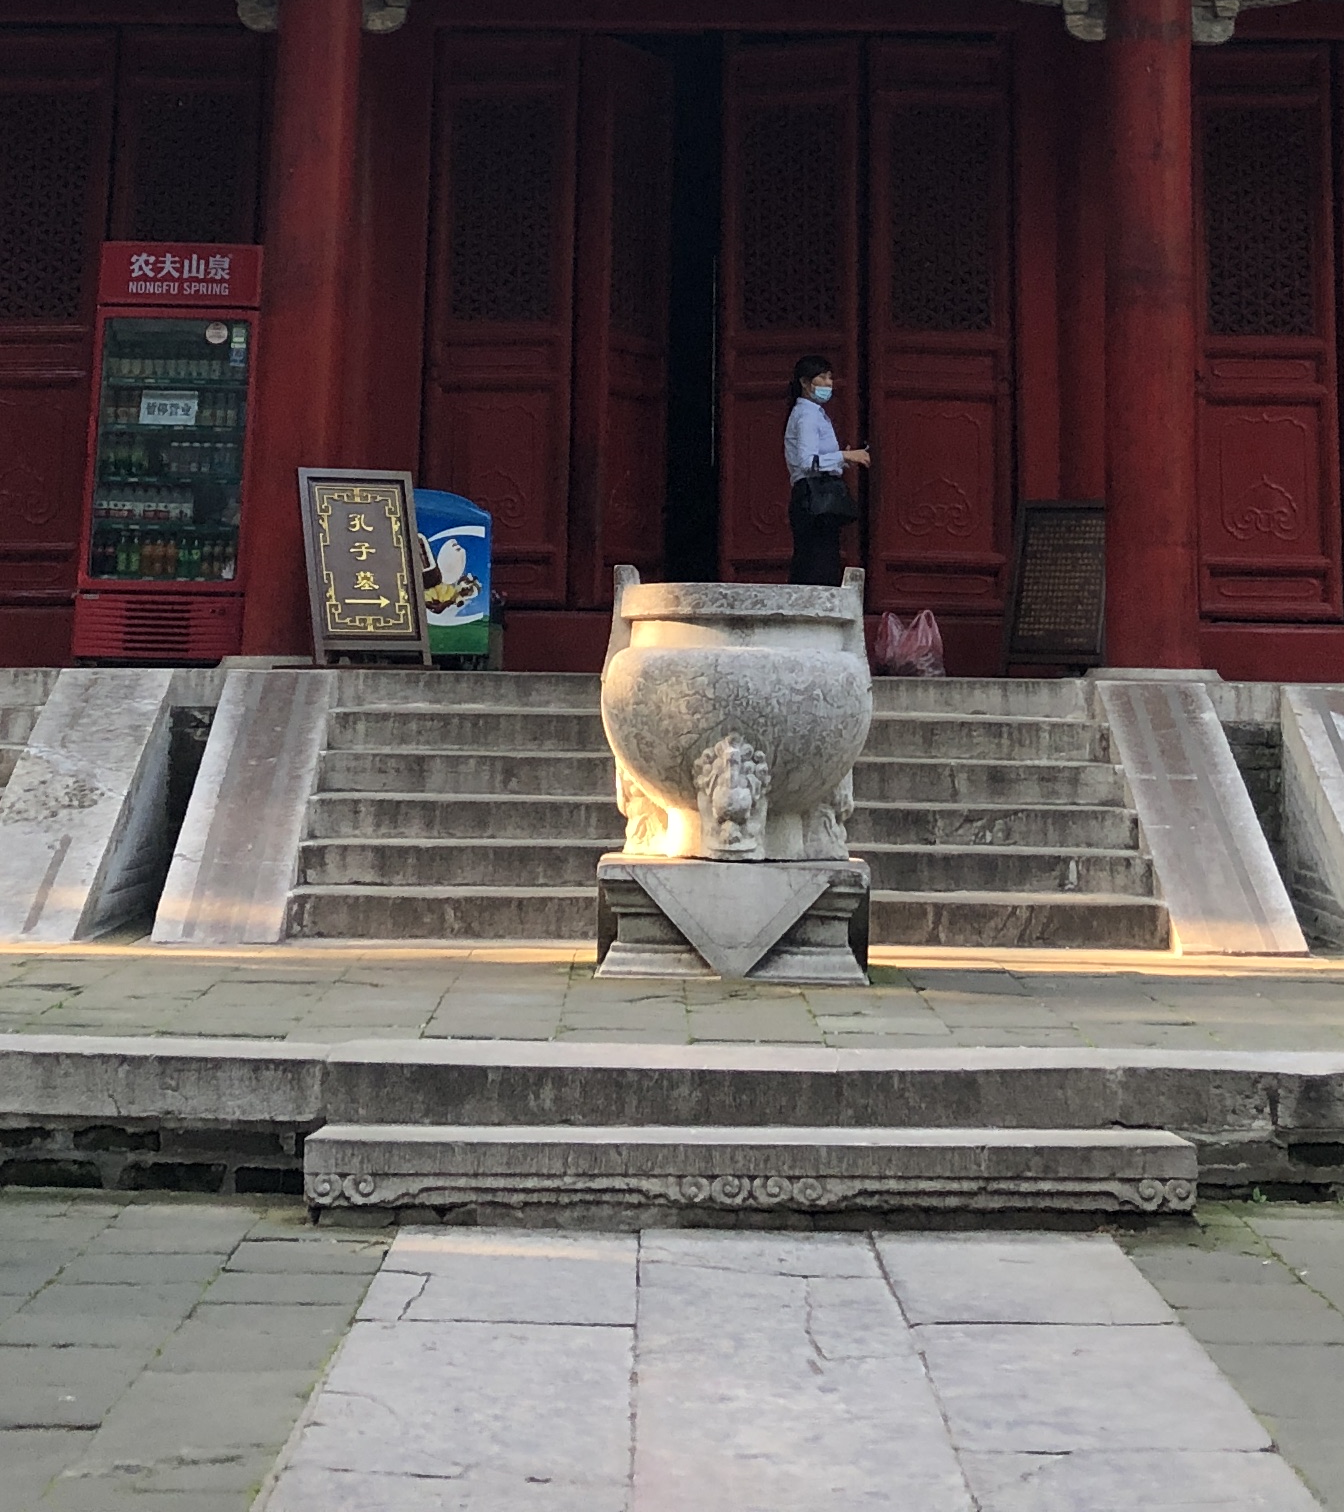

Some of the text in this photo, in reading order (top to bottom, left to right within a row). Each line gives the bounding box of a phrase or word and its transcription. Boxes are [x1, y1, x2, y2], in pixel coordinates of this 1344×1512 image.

[130, 252, 230, 280] 农夫山泉
[128, 281, 229, 296] NONGFU SPRING
[347, 513, 380, 591] 孔子墓
